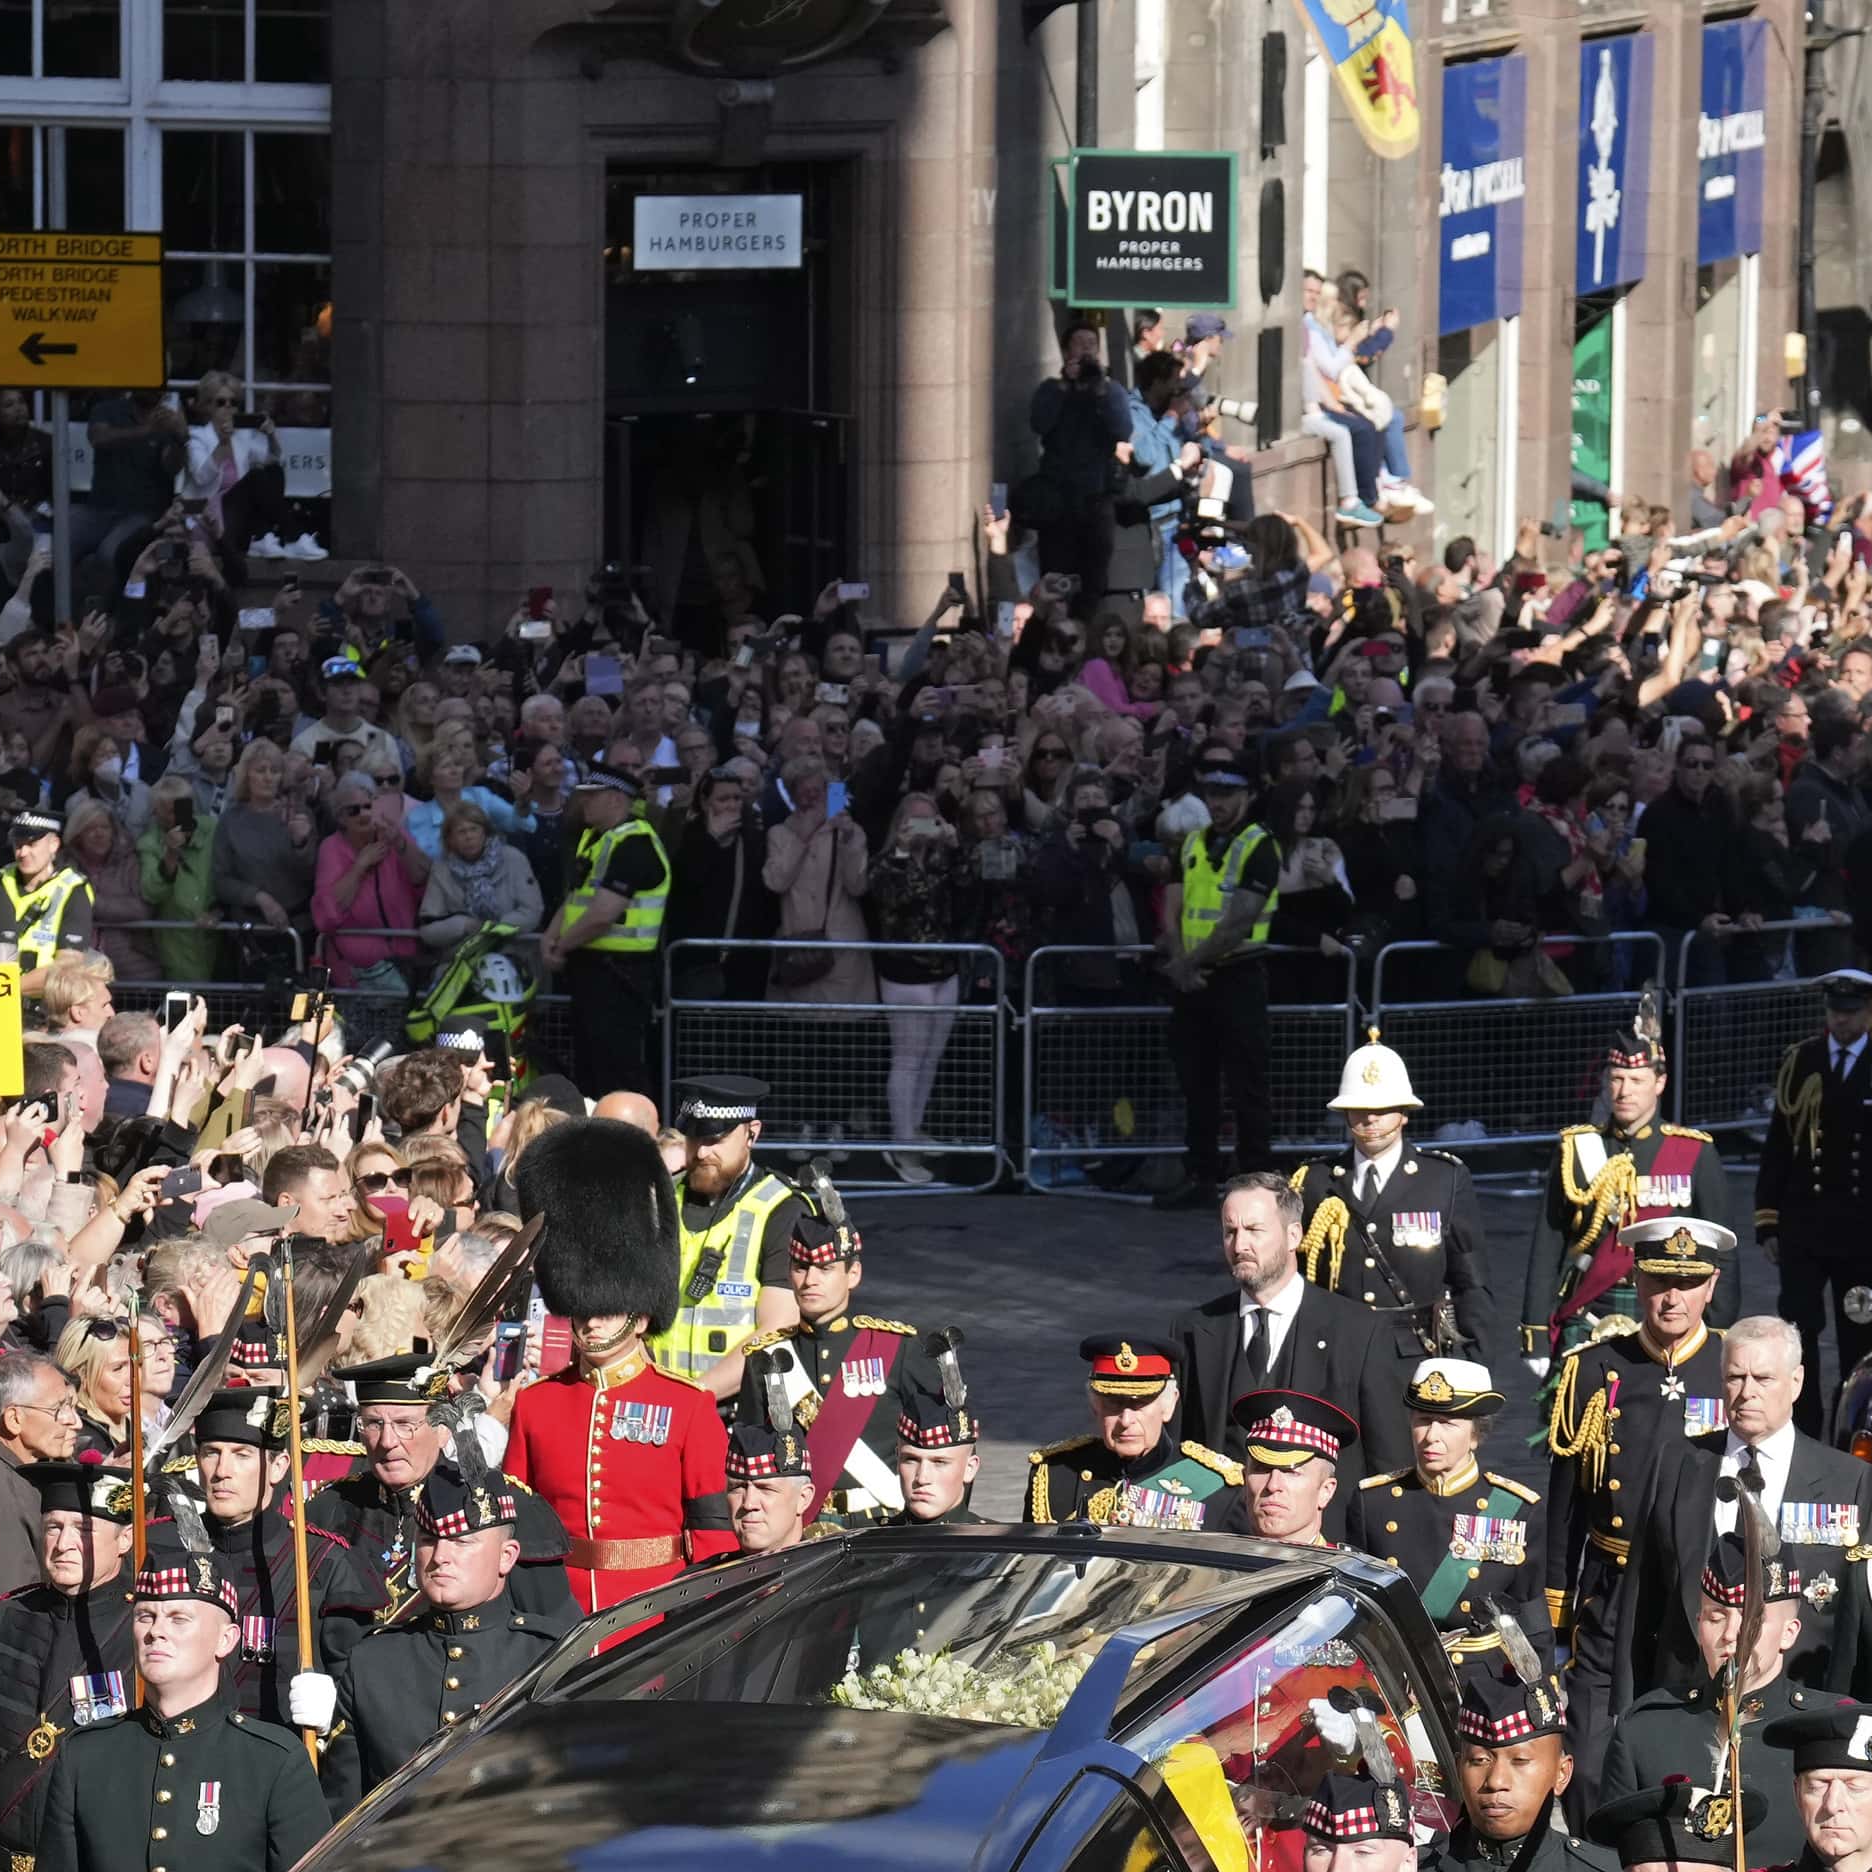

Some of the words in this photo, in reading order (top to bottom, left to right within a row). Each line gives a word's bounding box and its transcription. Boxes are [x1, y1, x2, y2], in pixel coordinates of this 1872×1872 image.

[1088, 190, 1214, 232] BYRON
[680, 212, 757, 229] PROPER
[56, 238, 134, 258] BRIDGE
[649, 235, 786, 251] HAMBURGERS
[1119, 240, 1181, 254] PROPER
[1096, 256, 1204, 271] HAMBURGERS
[52, 267, 120, 284] BRIDGE
[0, 286, 112, 303] PEDESTRIAN
[11, 306, 99, 322] WALKWAY
[718, 1283, 750, 1295] POLICE
